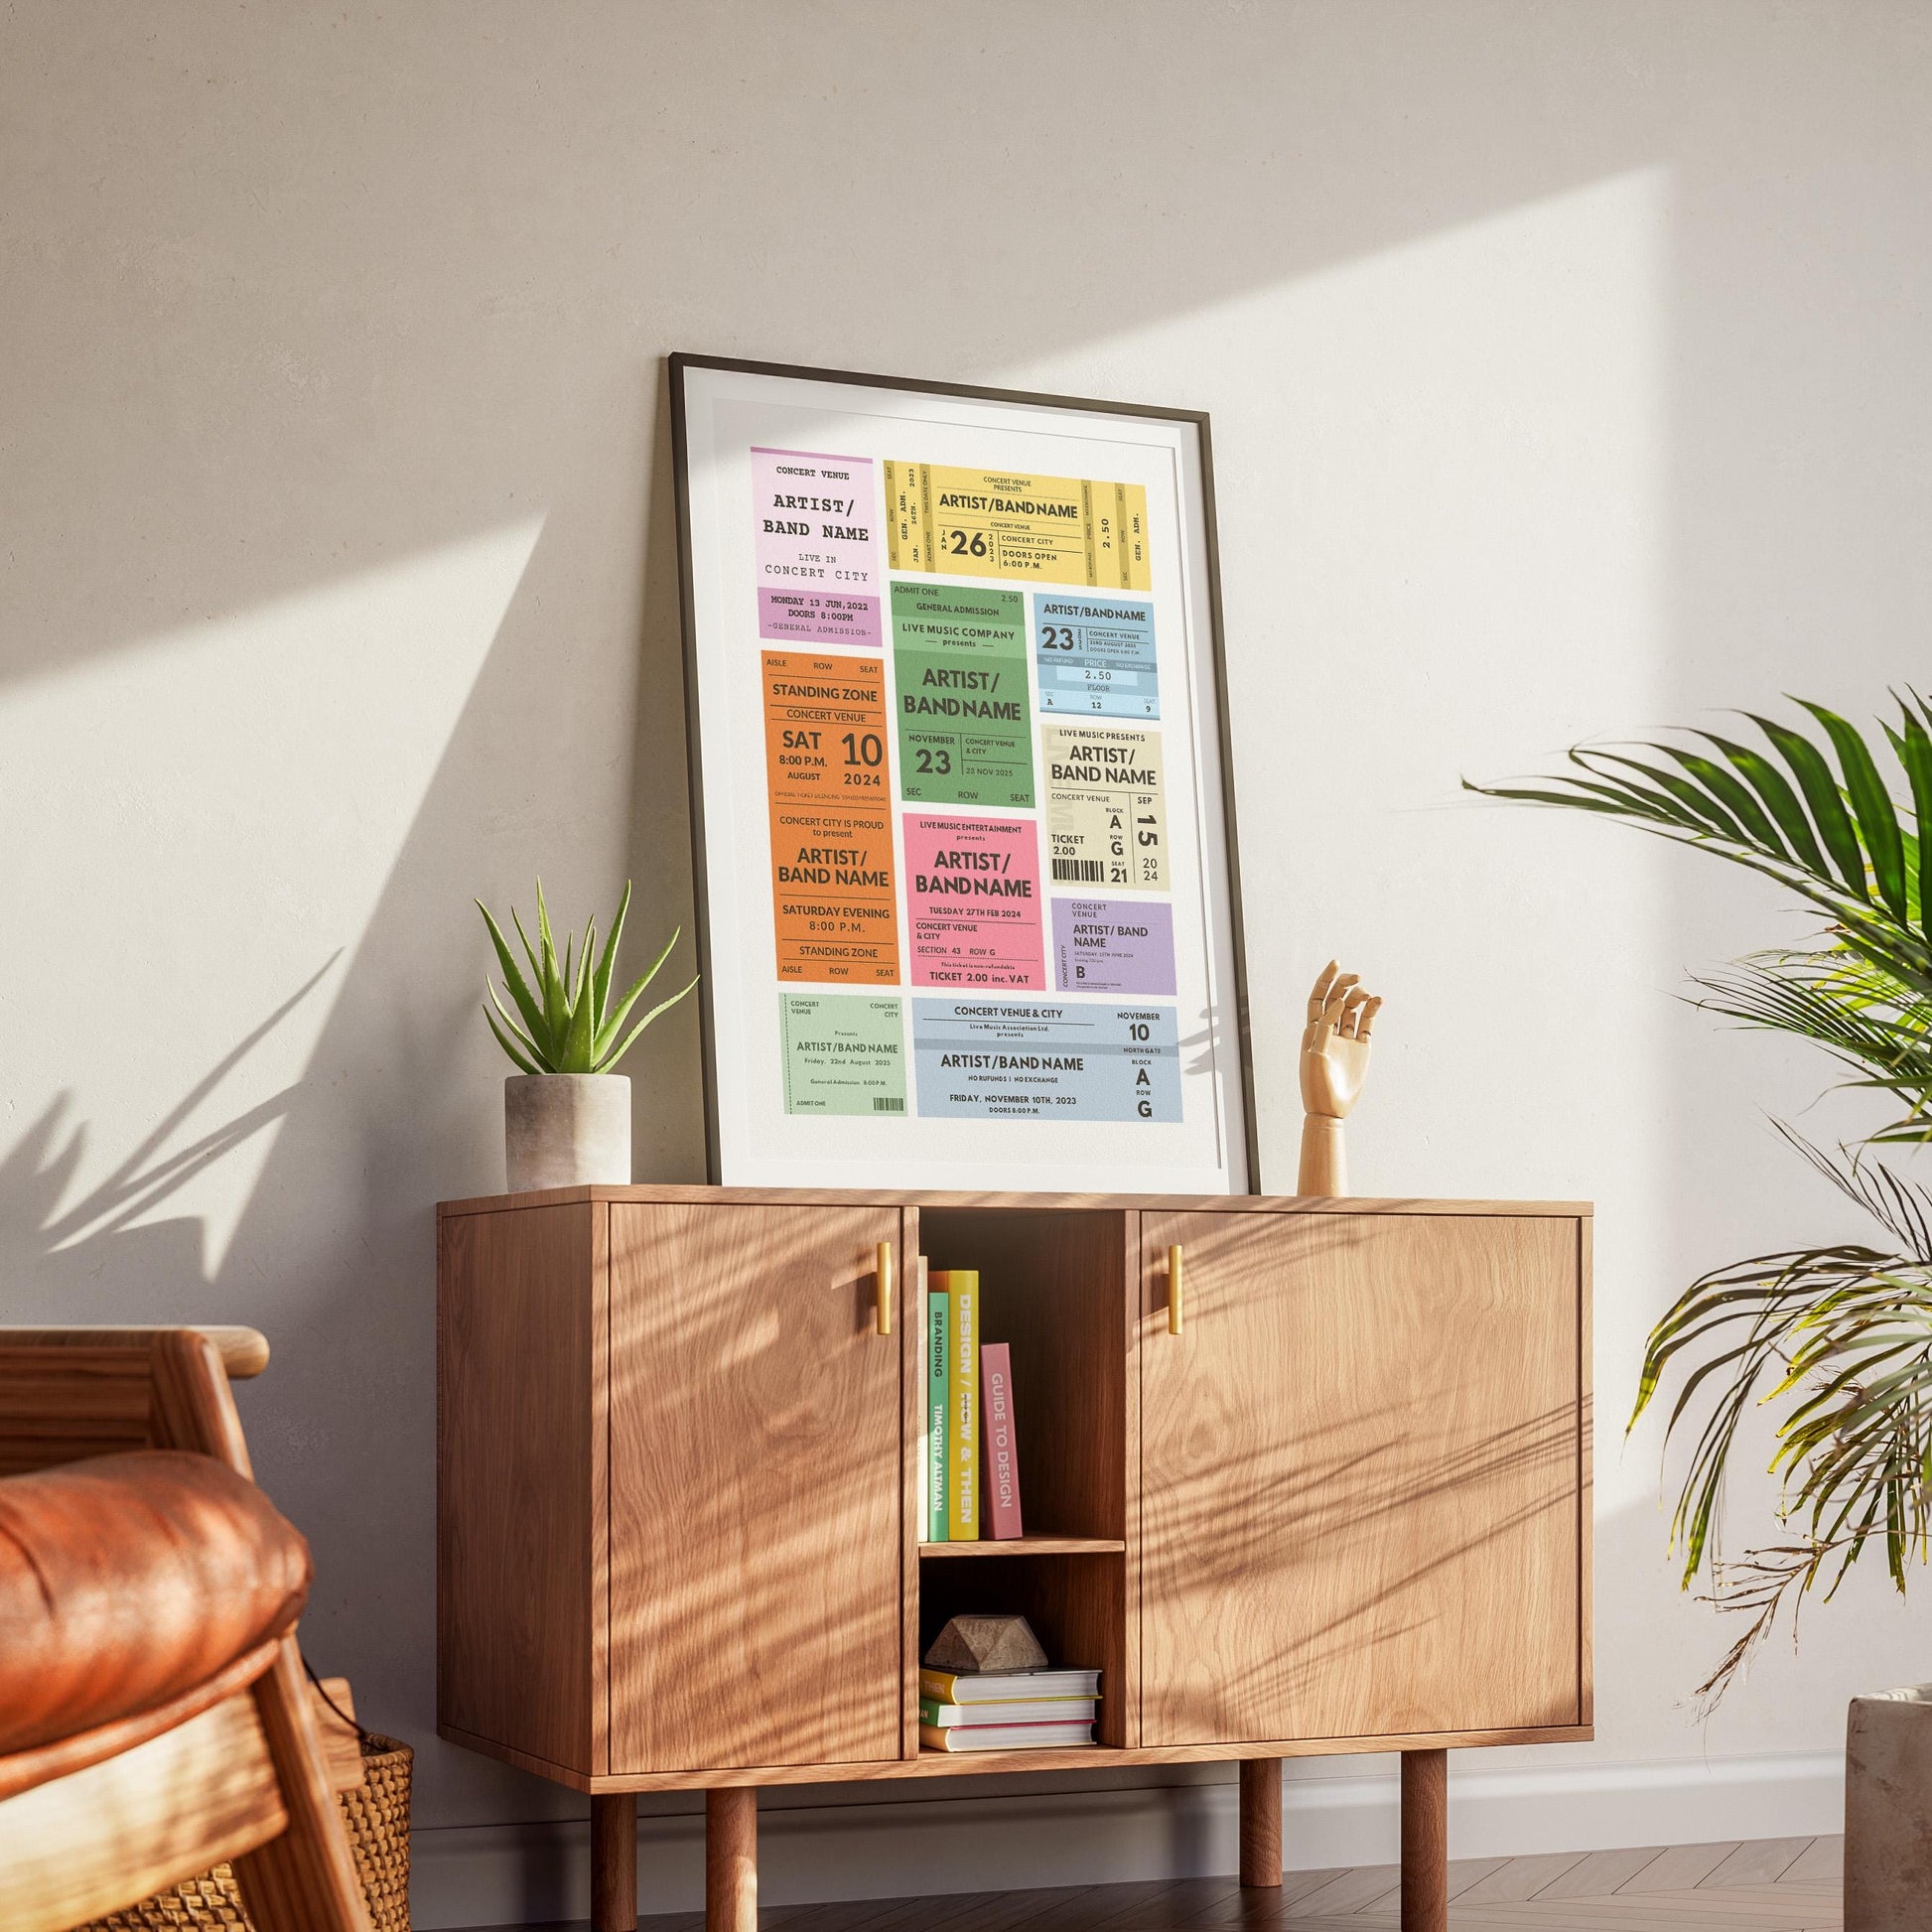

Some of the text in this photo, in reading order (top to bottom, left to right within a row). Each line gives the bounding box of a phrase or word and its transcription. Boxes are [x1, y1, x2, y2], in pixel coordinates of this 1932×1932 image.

[776, 466, 850, 481] CONCERT VENUE
[773, 494, 854, 517] ARTIST/
[762, 519, 869, 541] BAND NAME
[950, 530, 986, 557] 26
[1002, 535, 1035, 544] CONCERT
[798, 554, 821, 563] LIVE
[1003, 550, 1033, 559] DOORS
[764, 565, 868, 582] CONCERT CITY
[894, 586, 919, 595] ADMIT
[788, 610, 854, 621] DOORS 8:00PM
[916, 603, 1000, 617] GENERAL ADMISSION
[902, 623, 1015, 640] LIVE MUSIC COMPANY
[1041, 626, 1074, 650] 23
[766, 658, 787, 667] AISLE
[1084, 659, 1107, 668] PRICE
[922, 668, 1000, 693] ARTIST/
[1085, 670, 1112, 680] 2.50
[773, 684, 878, 702] STANDING ZONE
[786, 709, 866, 723] CONCERT VENUE
[782, 731, 822, 750] SAT
[908, 735, 955, 746] NOVEMBER
[1059, 729, 1078, 738] LIVE
[1079, 731, 1105, 740] MUSIC
[842, 733, 883, 766] 10
[1069, 746, 1136, 765] ARTIST/
[779, 755, 828, 766] 8:00 P.M.
[915, 749, 951, 775] 23
[787, 771, 820, 780] AUGUST
[844, 773, 881, 786] 2024
[1051, 763, 1157, 785] BAND NAME
[779, 816, 821, 826] CONCERT
[823, 819, 842, 828] CITY
[853, 821, 884, 830] PROUD
[1110, 815, 1122, 829] A
[1051, 834, 1084, 844] TICKET
[1053, 846, 1075, 856] 2.00
[1111, 841, 1124, 856] G
[797, 848, 868, 867] ARTIST/
[934, 851, 1011, 874] ARTIST/
[1143, 858, 1158, 869] 20
[778, 867, 890, 888] BAND NAME
[1111, 868, 1127, 883] 21
[1144, 871, 1159, 882] 24
[782, 905, 891, 919] SATURDAY EVENING
[929, 906, 964, 915] TUESDAY
[916, 922, 951, 931] CONCERT
[1073, 924, 1148, 937] ARTIST/ BAND
[1074, 937, 1106, 948] NAME
[799, 946, 878, 958] STANDING ZONE
[782, 965, 802, 974] AISLE
[1076, 966, 1085, 979] B
[929, 972, 962, 982] TICKET
[967, 973, 988, 982] 2.00
[1010, 975, 1030, 984] VAT
[954, 1007, 999, 1017] CONCERT
[1000, 1008, 1031, 1018] VENUE
[1041, 1010, 1063, 1019] CITY
[1130, 1024, 1150, 1041] 10
[1136, 1068, 1151, 1086] A
[1138, 1100, 1153, 1118] G
[959, 1295, 972, 1374] DESIGN
[934, 1311, 943, 1378] BRANDING
[961, 1393, 971, 1441] NOW
[992, 1373, 1012, 1508] GUIDE TO DESIGN
[934, 1404, 943, 1511] TIMOTHY ALTMAN
[961, 1447, 972, 1462] &
[961, 1468, 972, 1523] THEN
